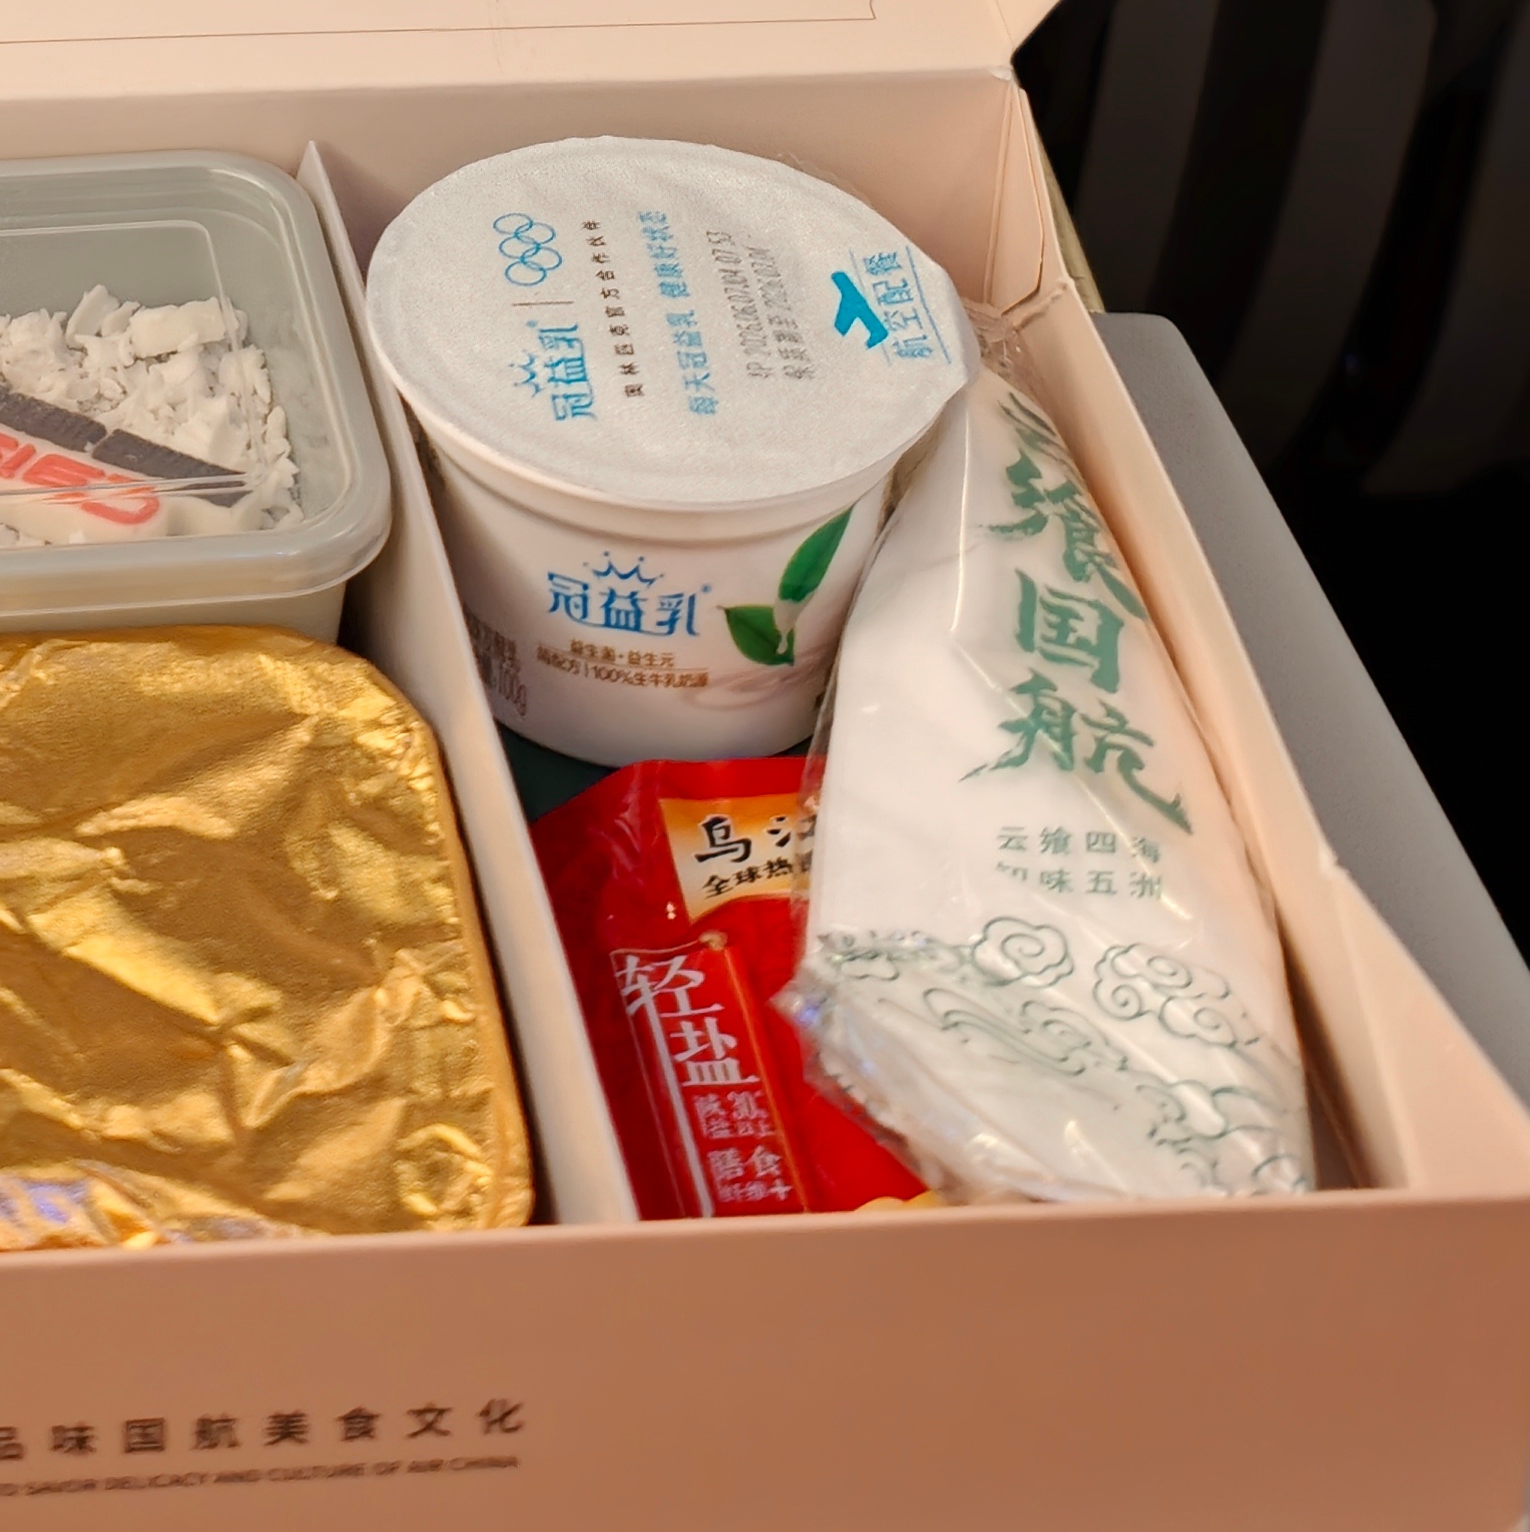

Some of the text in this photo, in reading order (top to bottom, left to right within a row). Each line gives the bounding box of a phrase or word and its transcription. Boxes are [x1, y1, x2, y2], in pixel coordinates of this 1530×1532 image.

[581, 218, 645, 399] 奥林匹克官方合作伙伴
[863, 250, 934, 362] 航空配餐
[539, 321, 598, 423] 冠益乳
[546, 570, 702, 638] 冠益乳
[614, 953, 761, 1088] 轻盐
